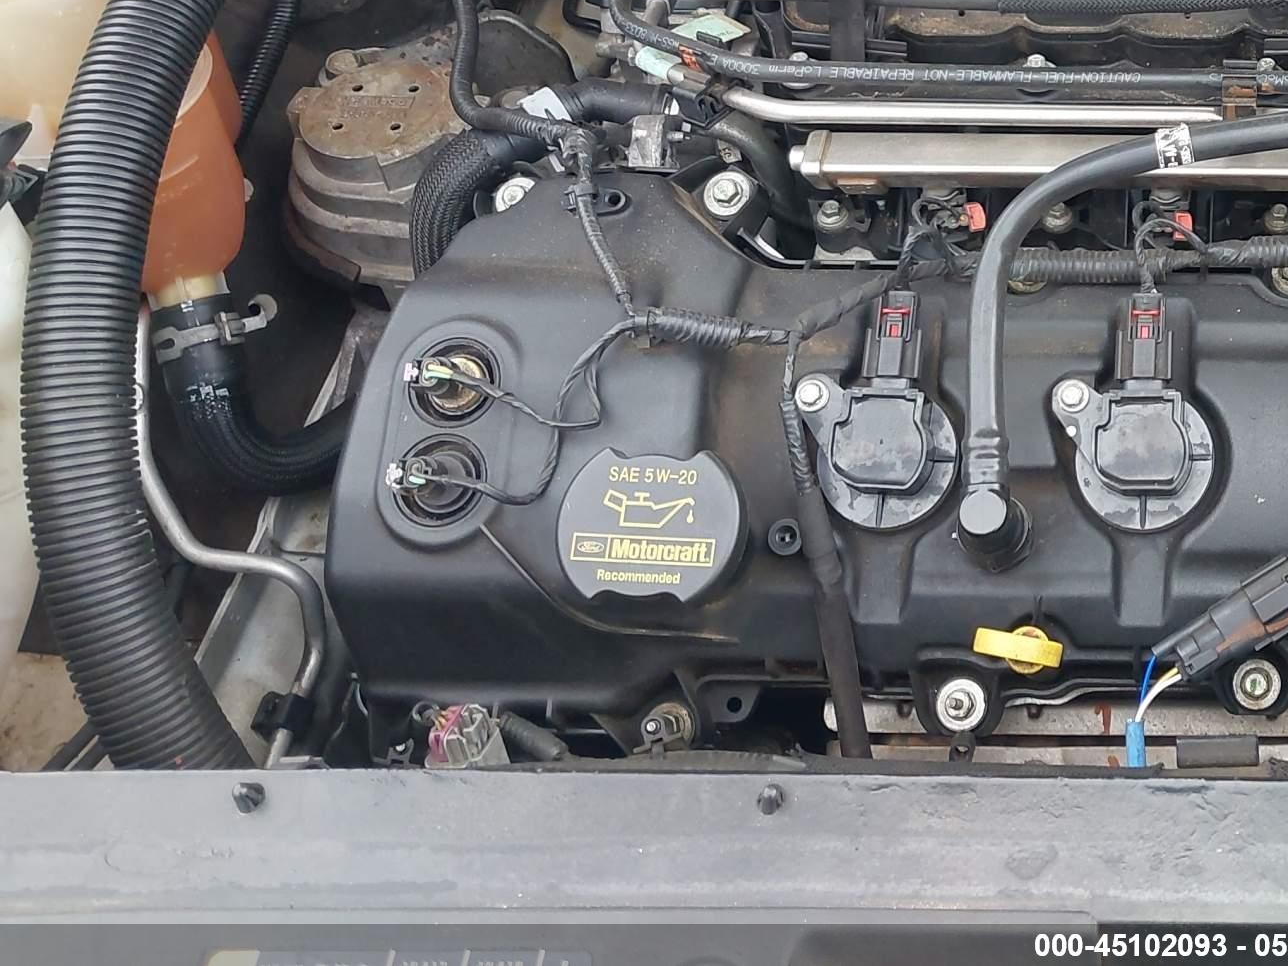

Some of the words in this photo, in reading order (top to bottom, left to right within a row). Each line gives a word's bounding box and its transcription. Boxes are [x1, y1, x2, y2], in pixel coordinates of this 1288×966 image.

[829, 66, 915, 81] REPAIRABLE
[608, 466, 641, 483] SAE
[644, 468, 698, 485] 5W-20
[596, 568, 681, 585] Recommended
